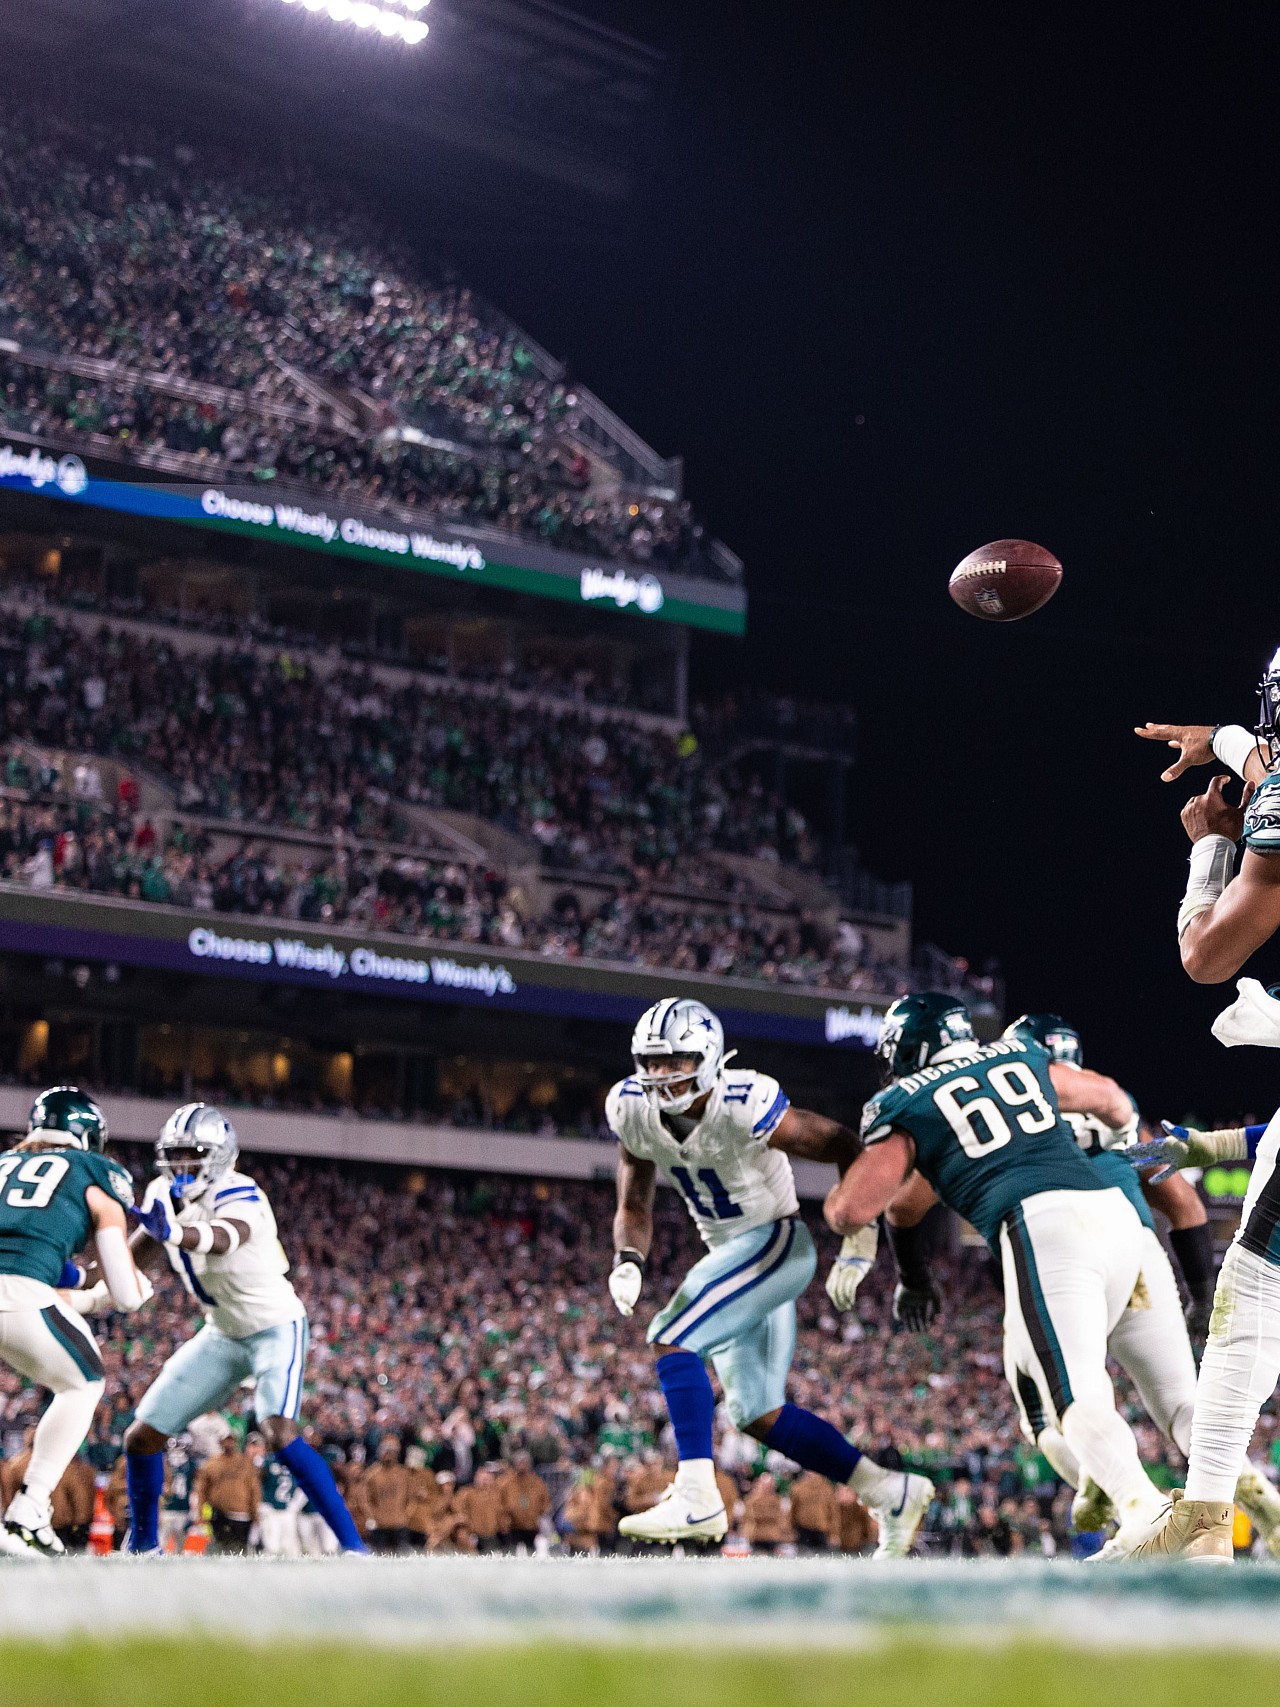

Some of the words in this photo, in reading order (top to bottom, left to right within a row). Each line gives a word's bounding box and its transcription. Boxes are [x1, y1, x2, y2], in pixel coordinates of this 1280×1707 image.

[201, 488, 274, 526] Choose
[340, 518, 410, 555] Choose
[188, 927, 272, 965] Choose
[350, 948, 430, 984] Choose
[724, 1083, 753, 1105] 11
[932, 1060, 1057, 1160] 69
[671, 1166, 744, 1220] 11
